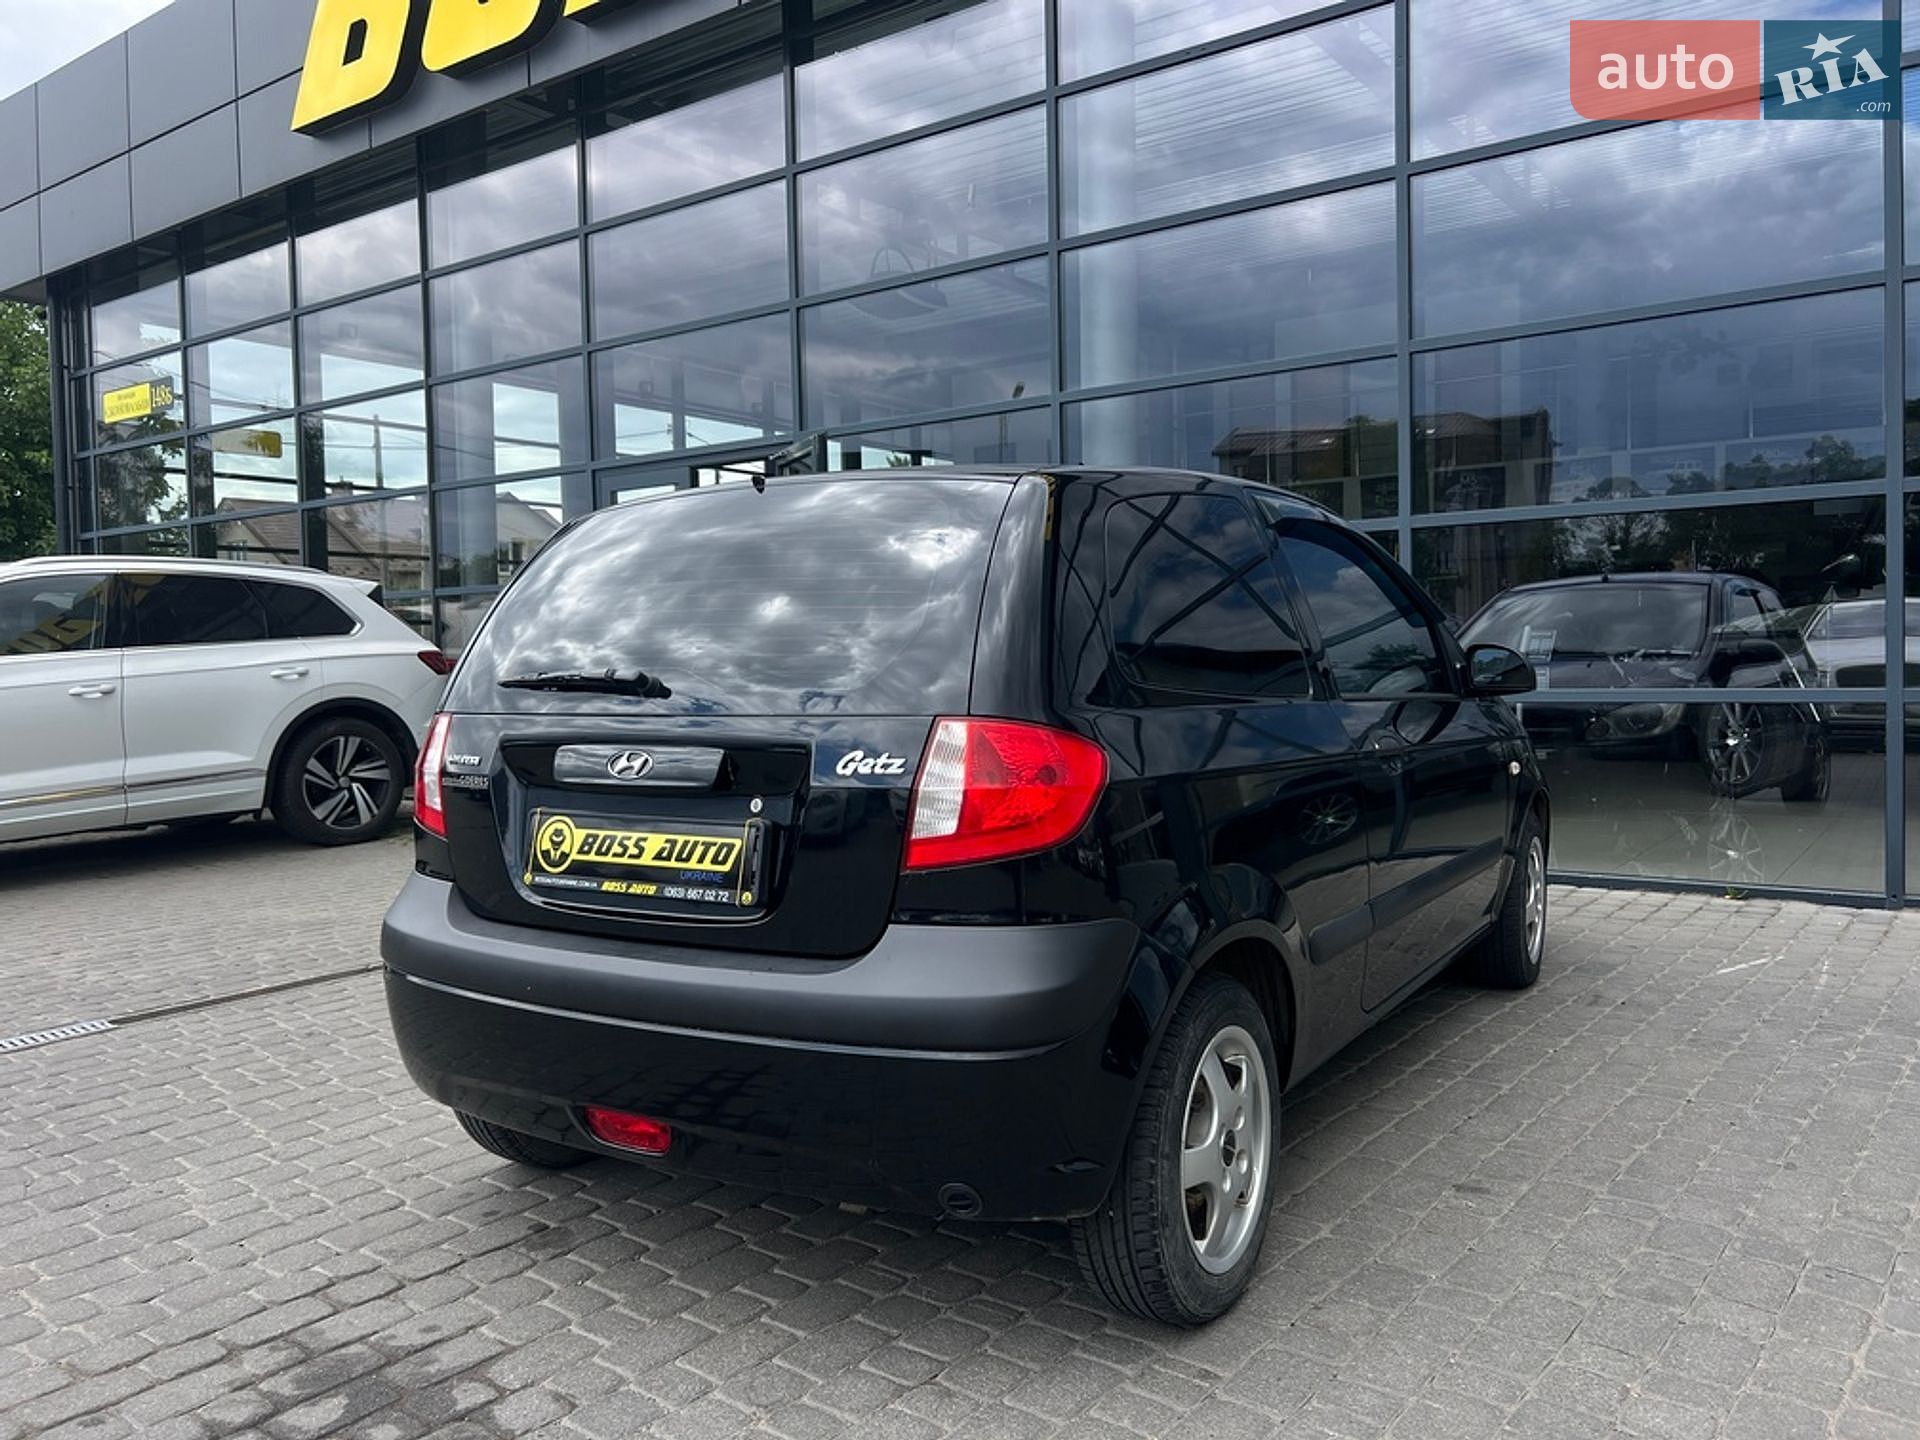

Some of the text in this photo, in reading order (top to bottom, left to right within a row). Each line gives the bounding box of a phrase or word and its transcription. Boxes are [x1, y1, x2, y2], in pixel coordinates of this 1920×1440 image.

[836, 750, 906, 776] Getz
[576, 832, 736, 866] BOSS AUTO
[680, 870, 725, 884] UKRAINE
[601, 879, 657, 896] BOSS AUTO
[718, 891, 729, 902] 72
